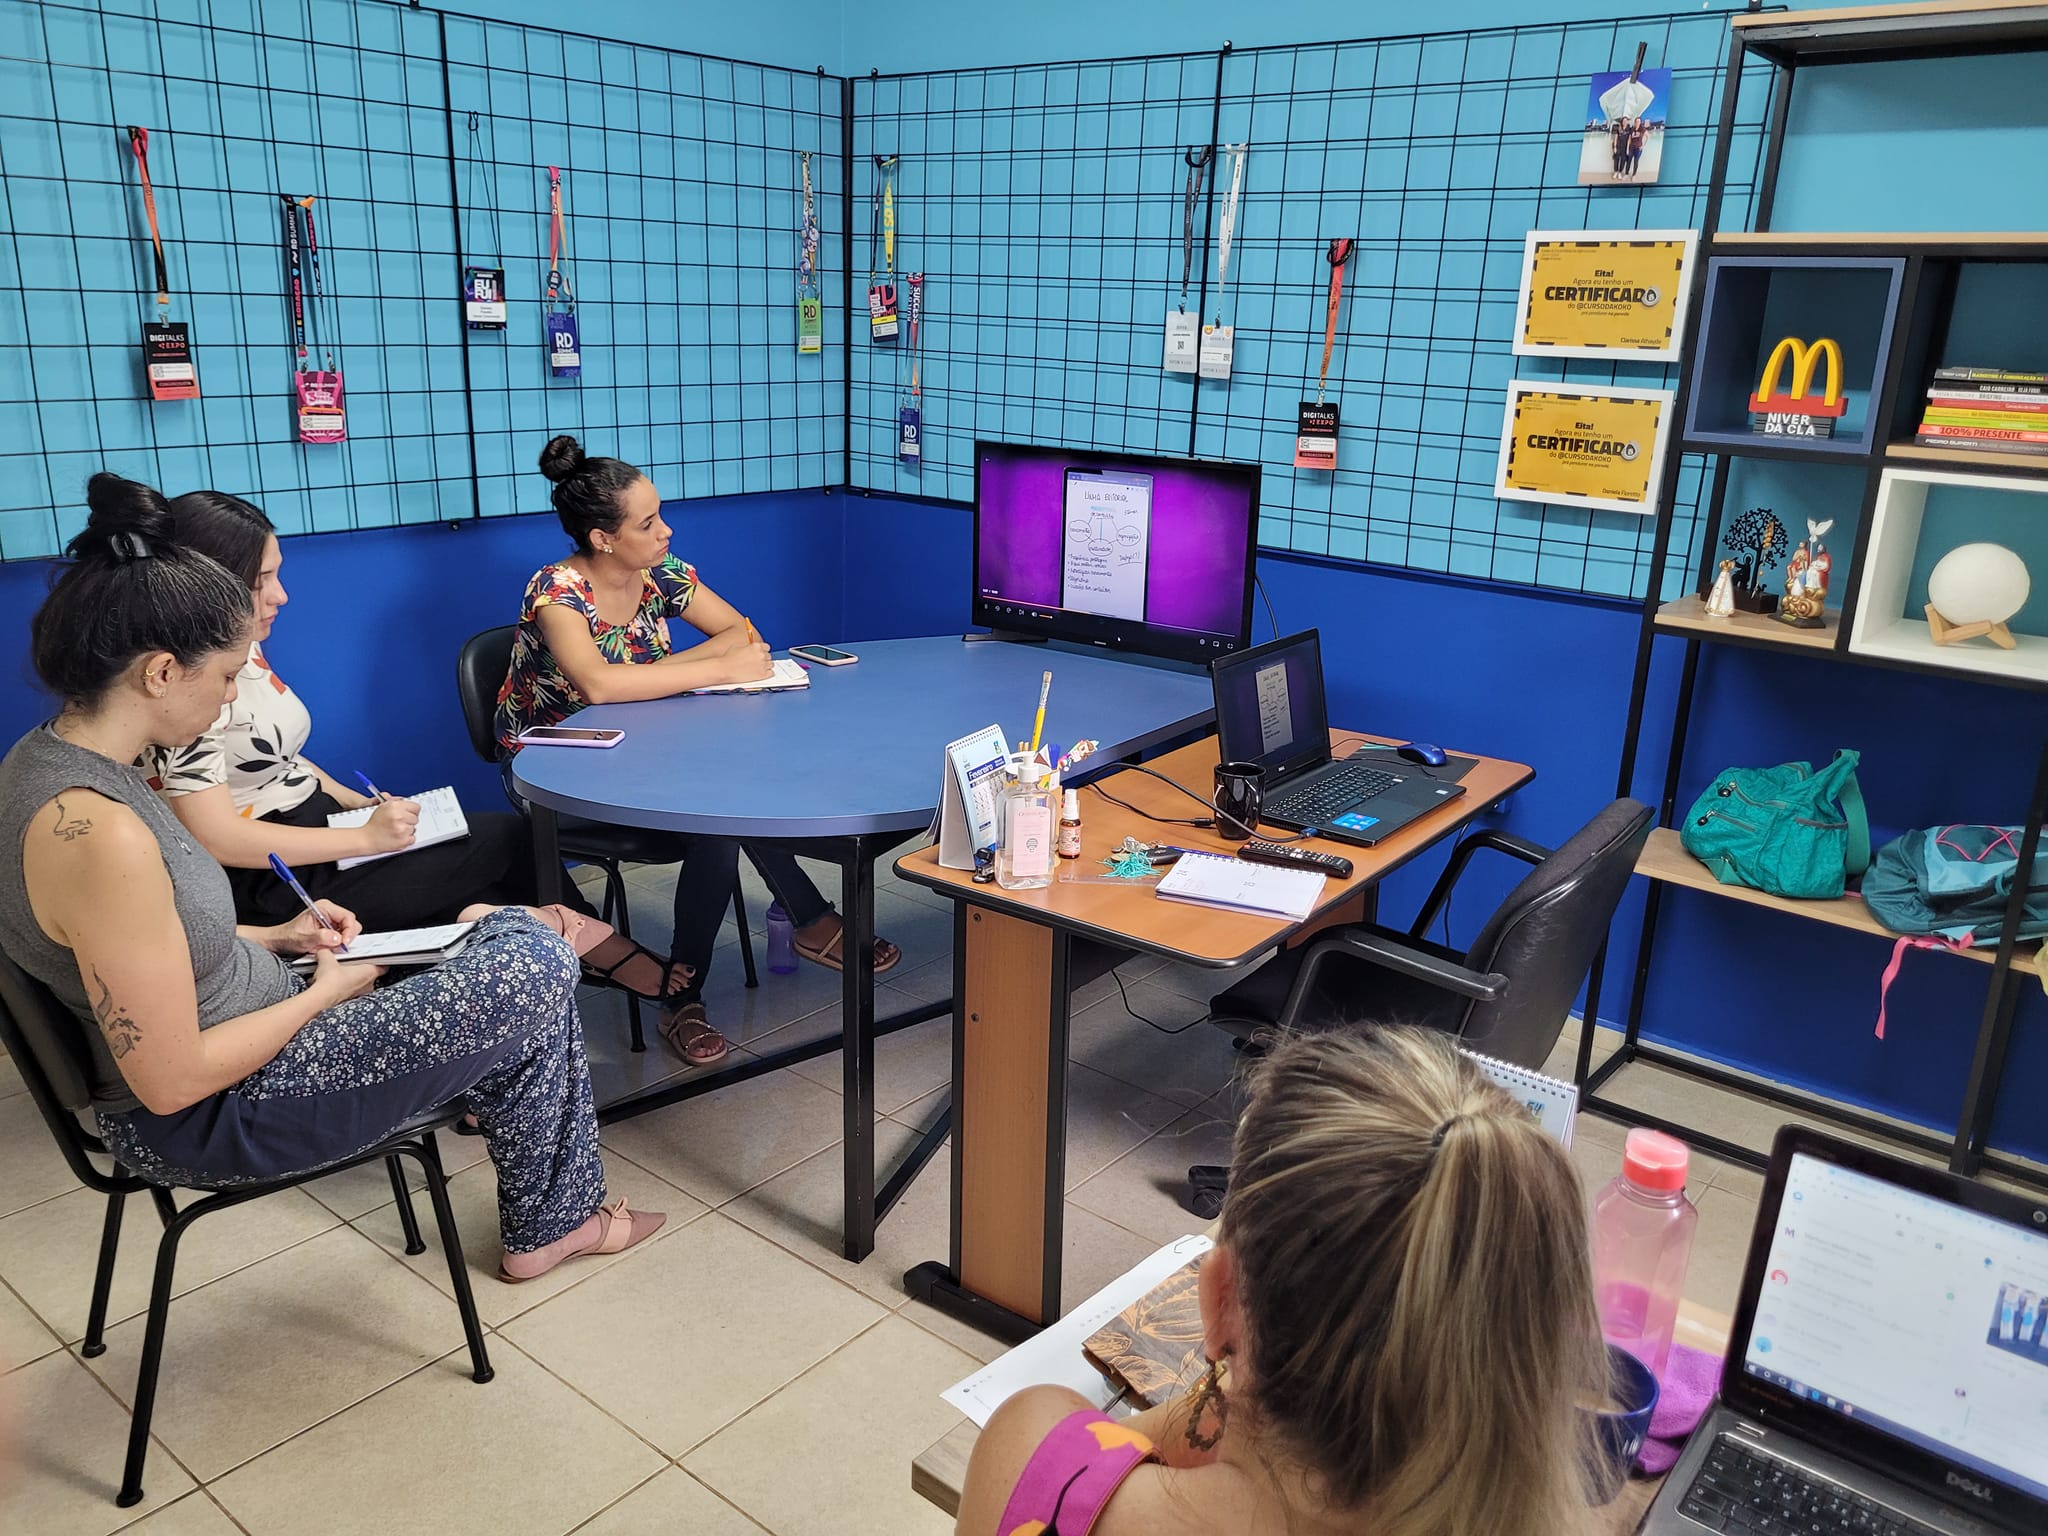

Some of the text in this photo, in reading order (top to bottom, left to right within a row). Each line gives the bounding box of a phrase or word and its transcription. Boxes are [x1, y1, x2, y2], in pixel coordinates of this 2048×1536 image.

[1594, 269, 1614, 278] Eita!
[1572, 278, 1592, 286] Agora
[1602, 278, 1621, 286] tenho
[804, 305, 817, 319] RD
[912, 287, 920, 324] SUCCESS
[1576, 303, 1632, 311] @CURSODAKOKO
[150, 333, 185, 343] DIGITALKS
[555, 332, 574, 348] RD
[1302, 411, 1335, 420] DIGITALKS
[1767, 412, 1810, 426] NIVER
[904, 425, 917, 438] RD
[1554, 428, 1573, 437] Agora
[1583, 430, 1601, 438] tenho
[1574, 422, 1594, 431] Eita!
[1764, 423, 1816, 436] DA CLA
[1940, 427, 2023, 440] 100% PRESENTE
[1558, 452, 1612, 463] @CURSODAKOKO
[968, 764, 994, 781] Fevereiro
[1946, 1471, 1993, 1501] DELL
